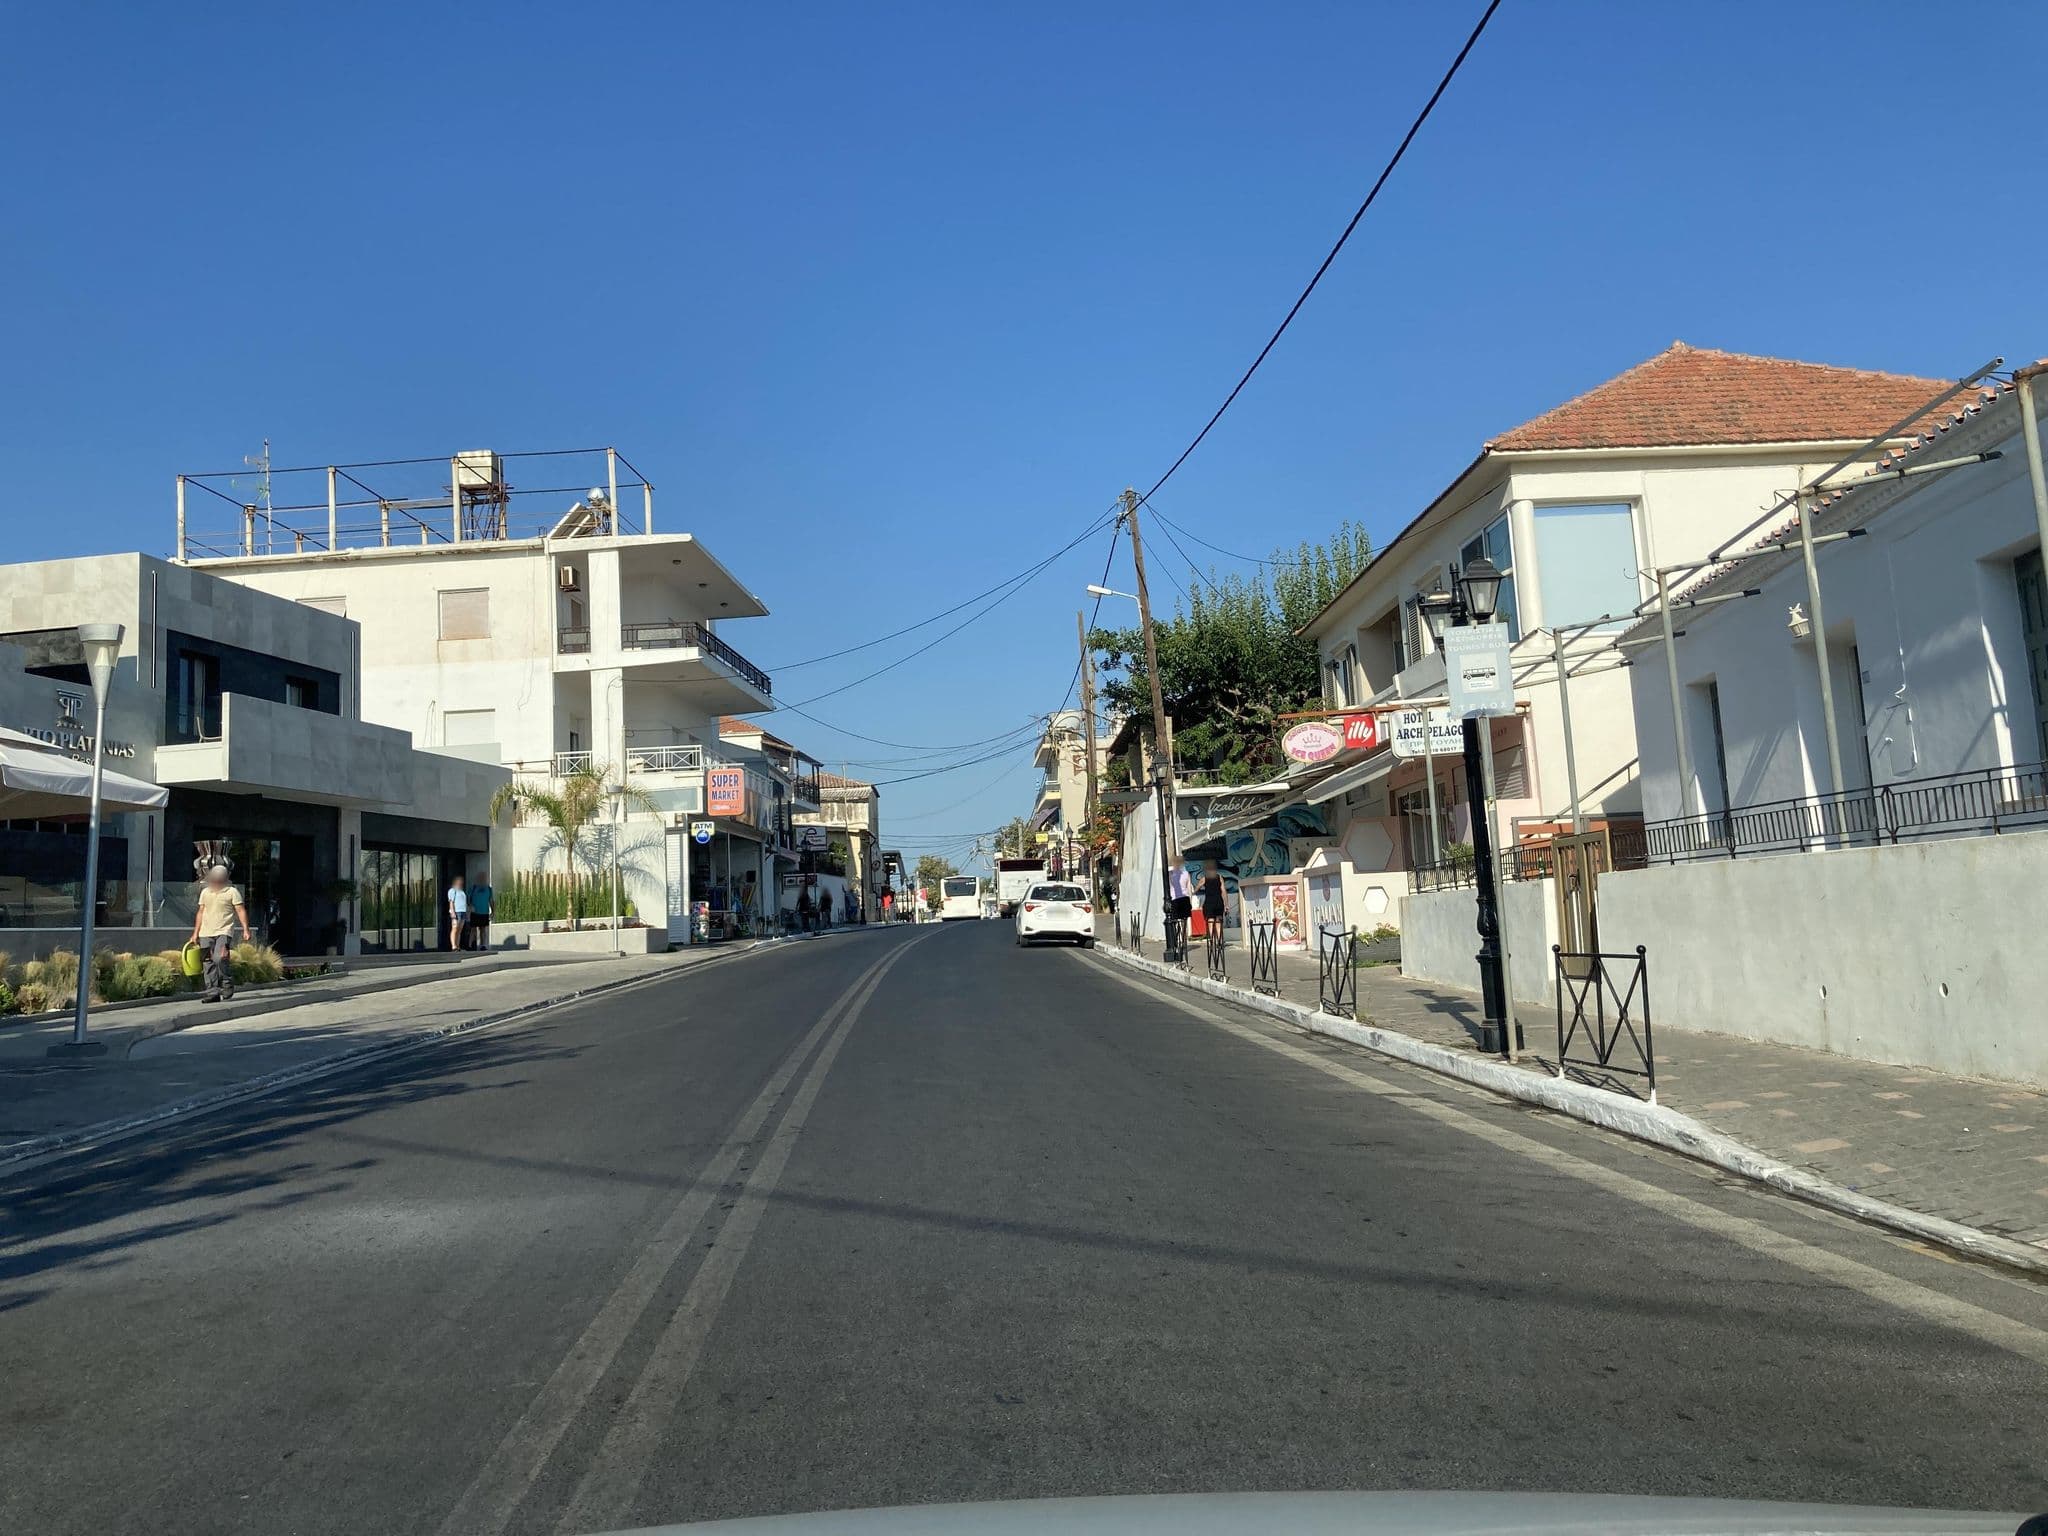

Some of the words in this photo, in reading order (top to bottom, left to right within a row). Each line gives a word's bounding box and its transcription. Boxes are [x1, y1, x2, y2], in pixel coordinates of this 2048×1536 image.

[1403, 711, 1434, 724] HOTL
[1348, 720, 1373, 743] illy
[1396, 725, 1464, 740] ARCHPELAGO
[60, 732, 136, 758] PLATNIAS
[712, 774, 739, 787] SUPER
[711, 790, 739, 801] MARKET
